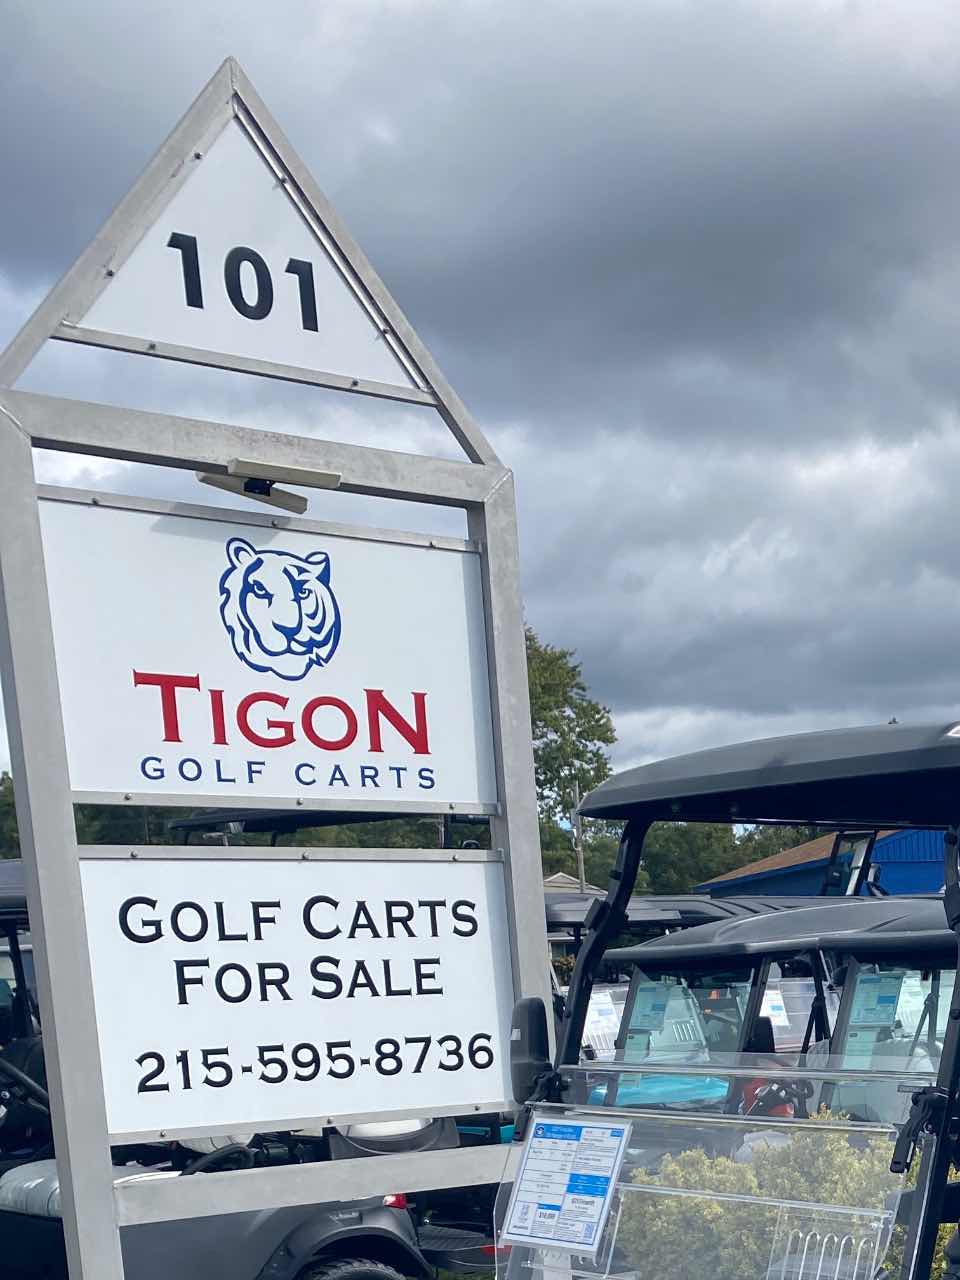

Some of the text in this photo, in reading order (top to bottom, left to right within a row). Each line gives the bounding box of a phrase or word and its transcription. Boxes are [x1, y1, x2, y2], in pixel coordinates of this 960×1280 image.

[167, 232, 319, 332] 101
[133, 671, 431, 755] TIGON
[141, 757, 436, 790] GOLF CARTS
[118, 895, 479, 944] GOLF CARTS
[173, 955, 444, 1005] FOR SALE
[134, 1032, 495, 1094] 215-595-8736
